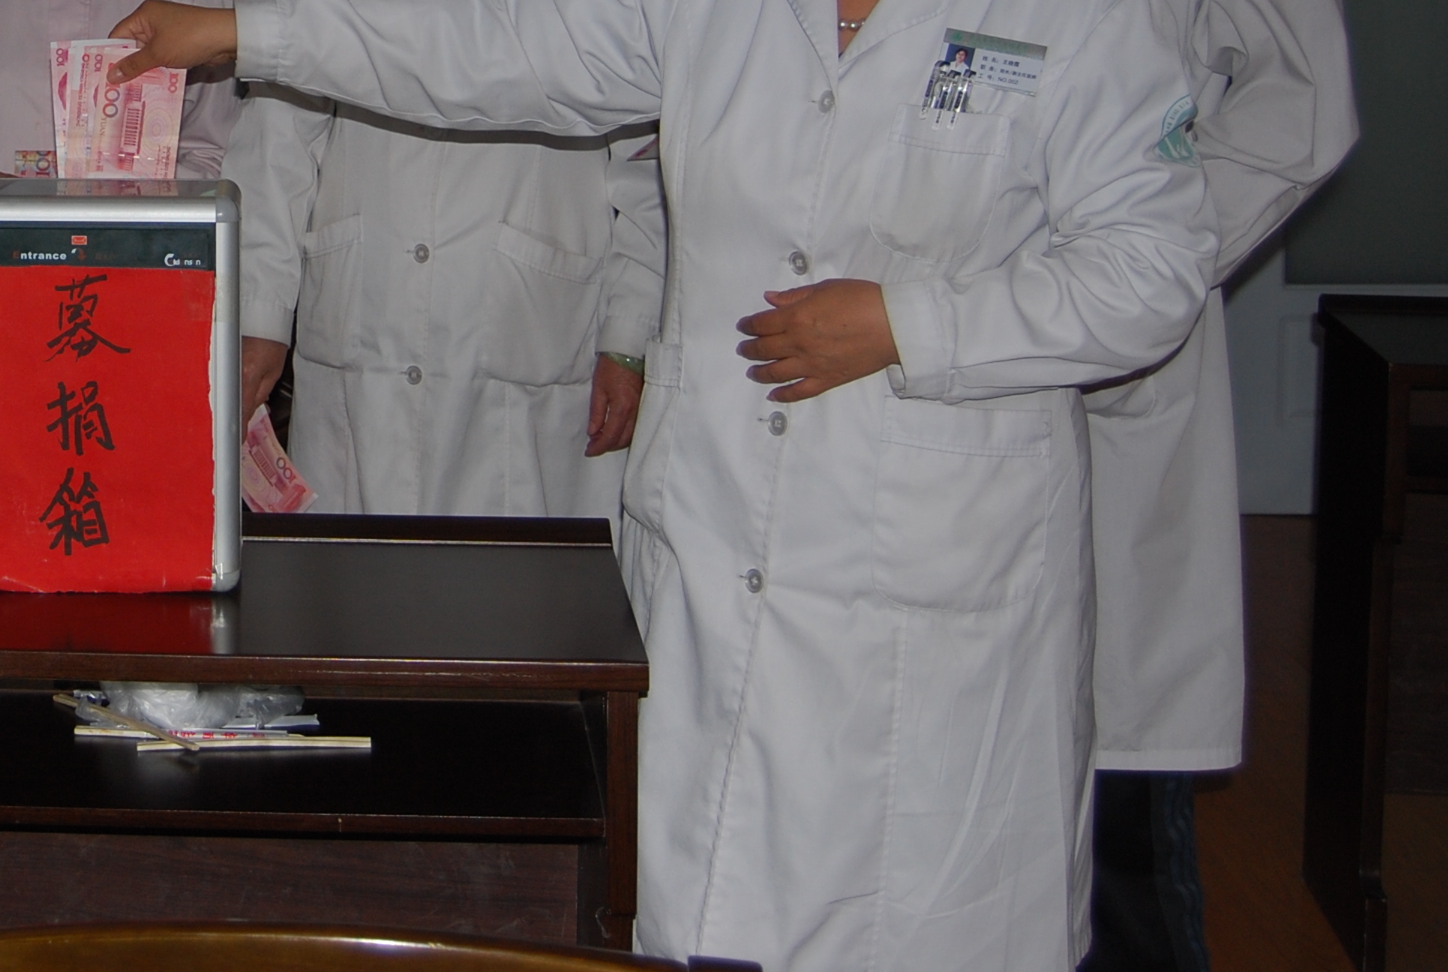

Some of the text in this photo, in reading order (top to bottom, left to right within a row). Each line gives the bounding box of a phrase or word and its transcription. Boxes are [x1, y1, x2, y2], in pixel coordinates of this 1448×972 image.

[55, 47, 65, 67] 100
[94, 53, 103, 72] 100
[12, 249, 67, 261] Entrance
[38, 273, 132, 557] 募捐箱
